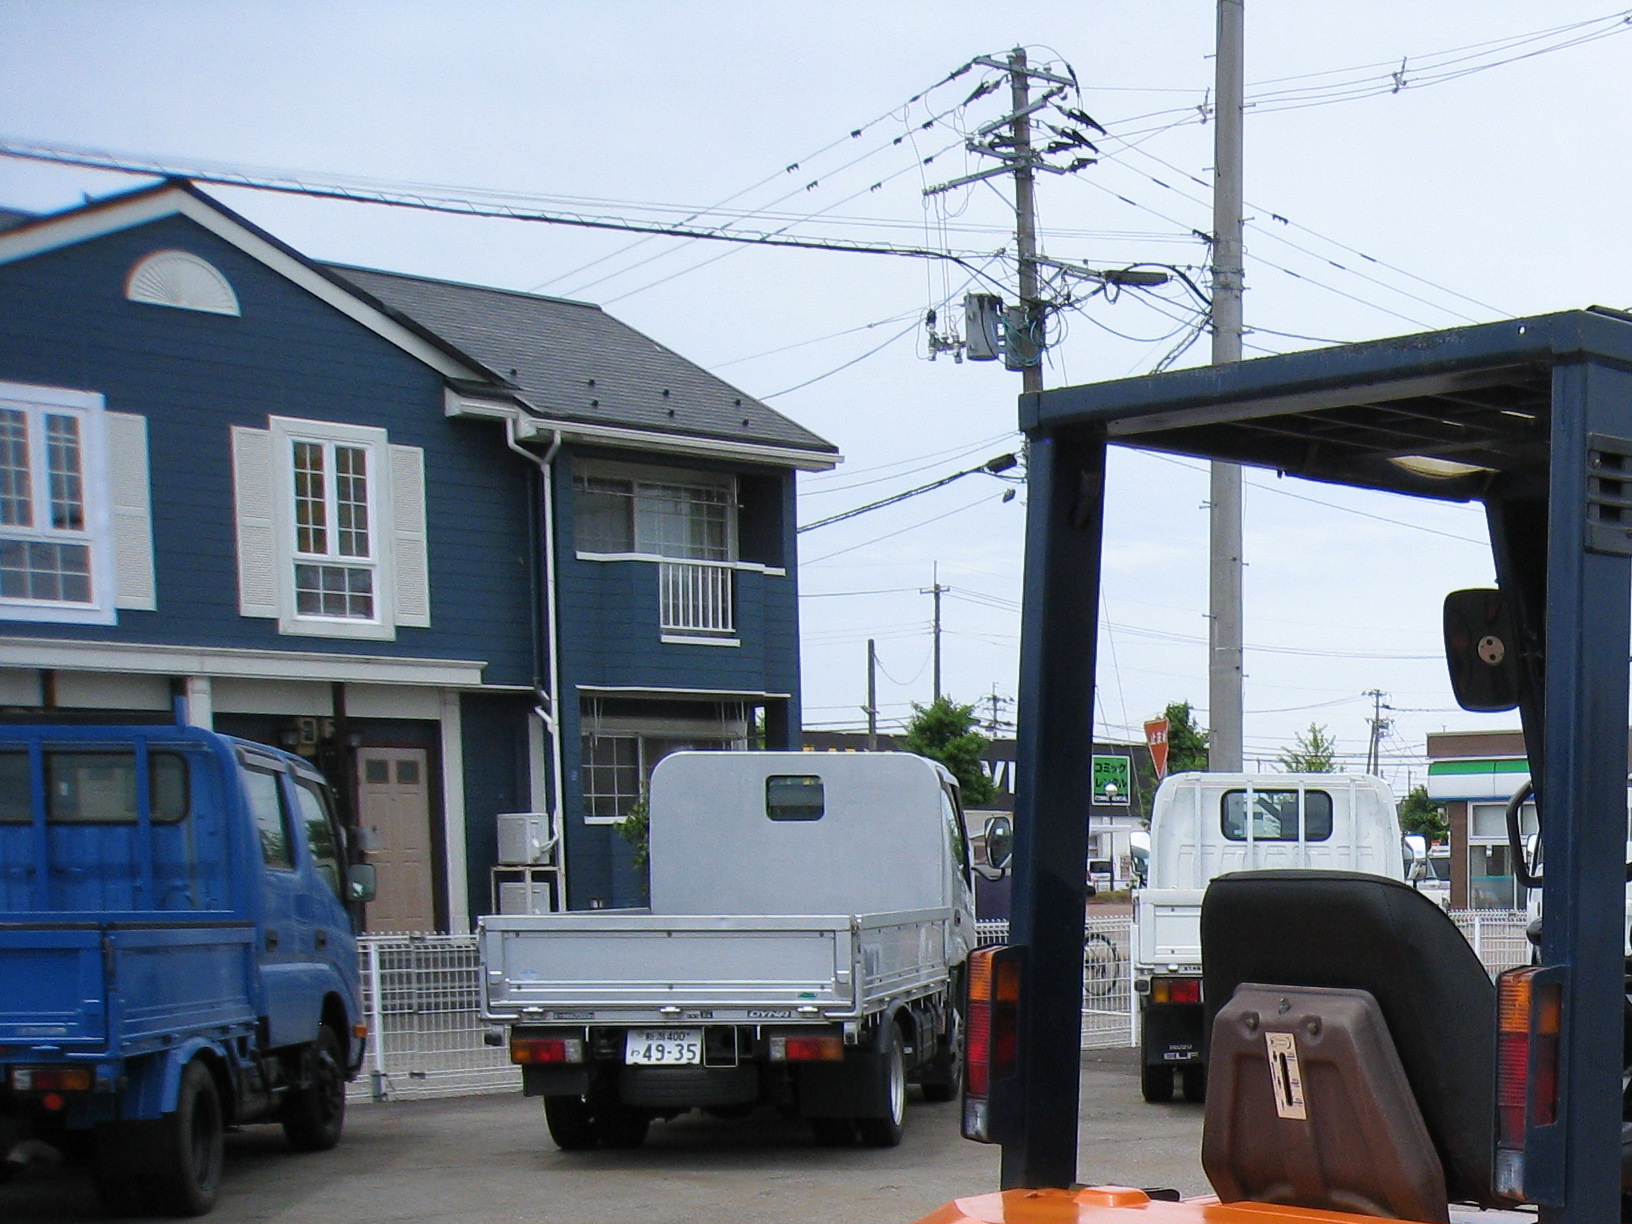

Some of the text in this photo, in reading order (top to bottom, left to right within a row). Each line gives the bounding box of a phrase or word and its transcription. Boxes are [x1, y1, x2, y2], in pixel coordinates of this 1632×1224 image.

[1094, 762, 1126, 774] コミック
[642, 1043, 698, 1062] 49-35
